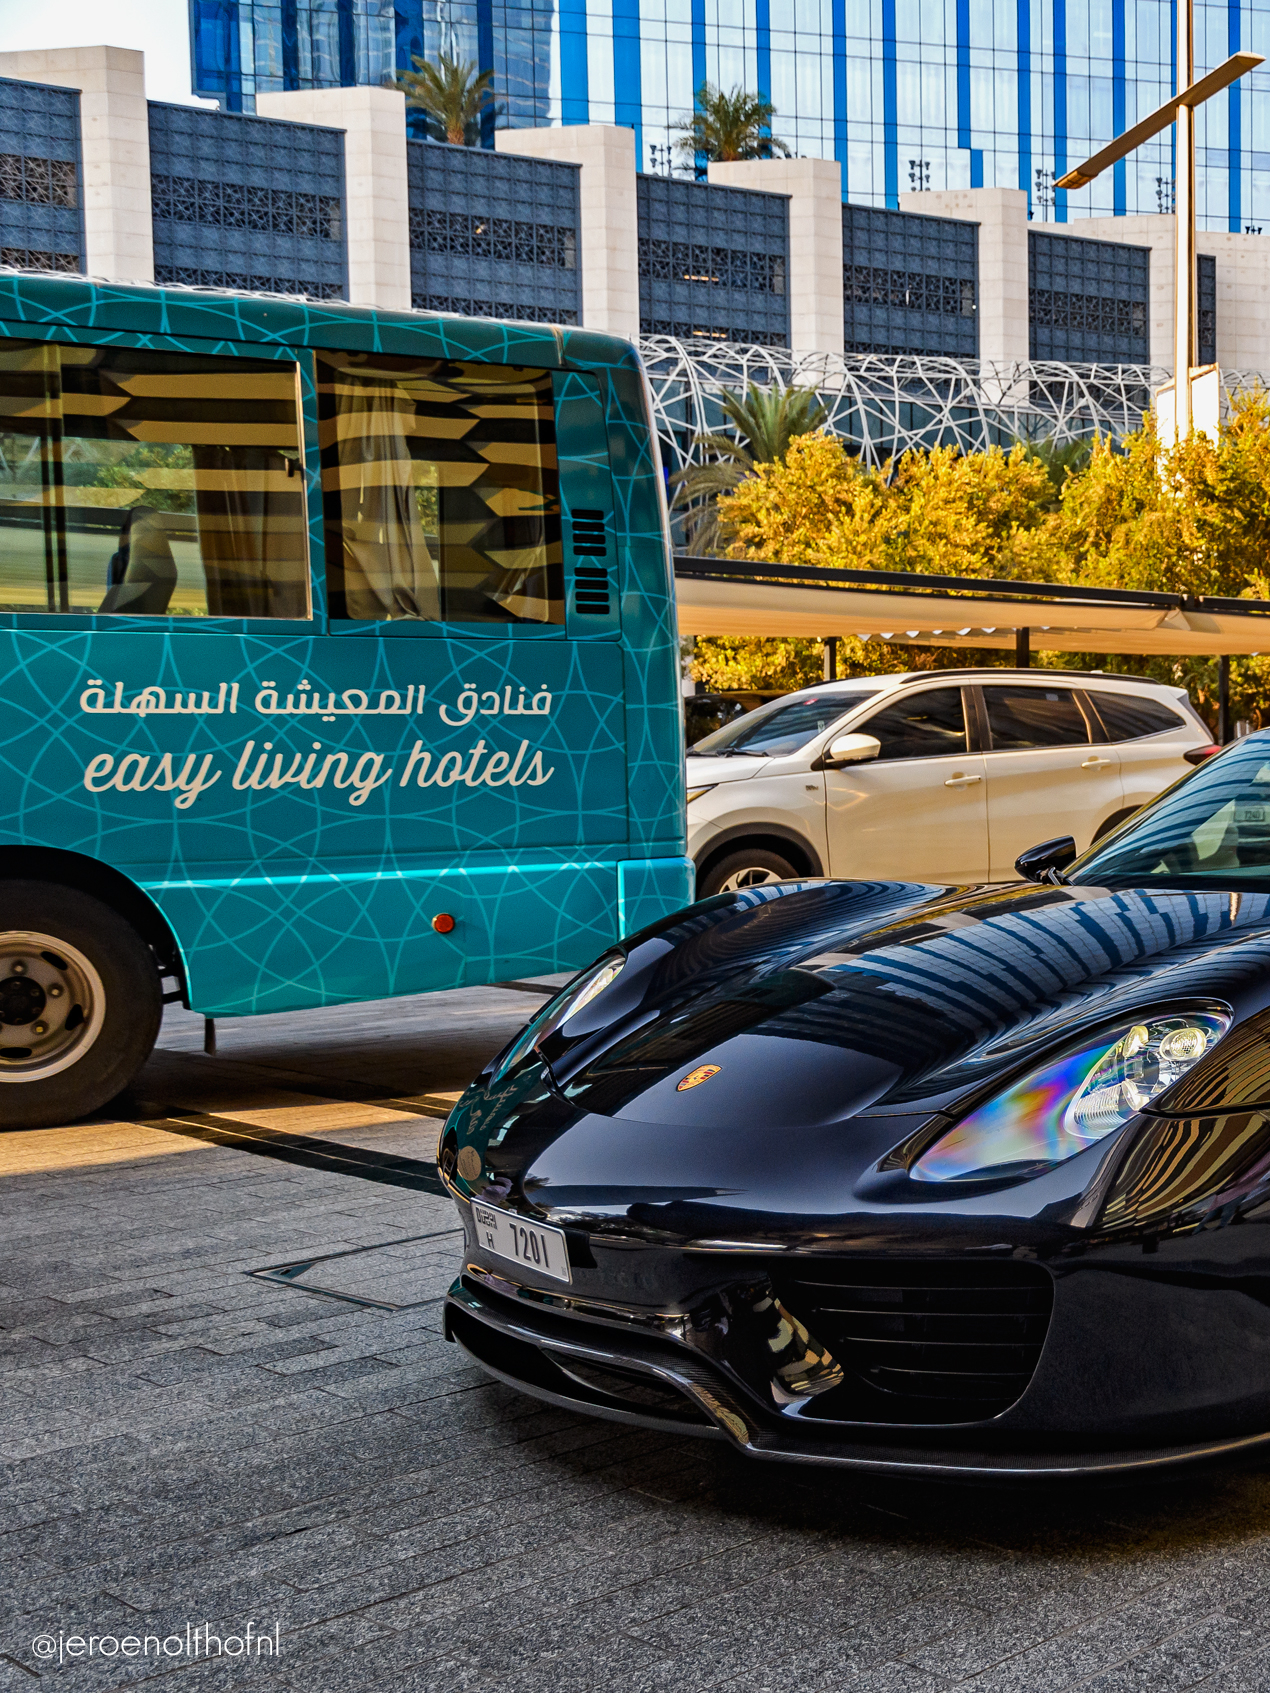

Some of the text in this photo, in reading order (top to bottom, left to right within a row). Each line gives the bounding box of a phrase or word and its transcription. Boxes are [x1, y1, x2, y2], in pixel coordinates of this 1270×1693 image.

[79, 679, 553, 727] فنادق المعيشة السهلة
[83, 739, 555, 810] easy living hotels
[485, 1230, 495, 1250] H
[508, 1222, 550, 1269] 7201
